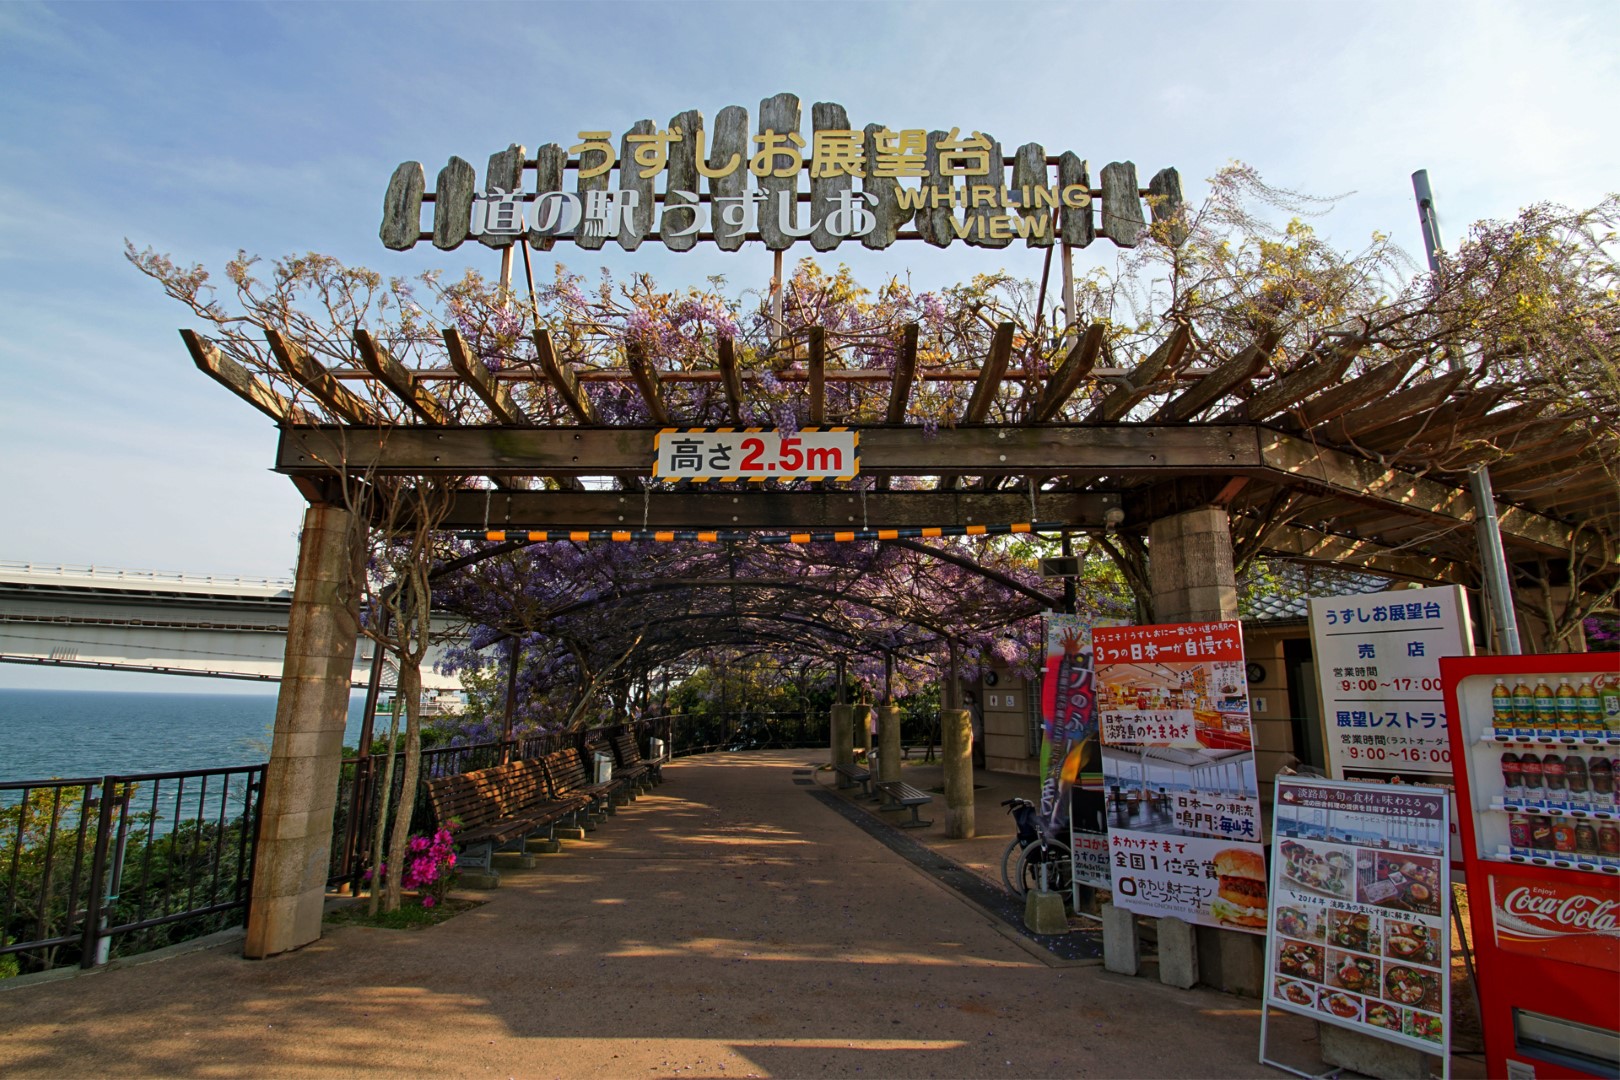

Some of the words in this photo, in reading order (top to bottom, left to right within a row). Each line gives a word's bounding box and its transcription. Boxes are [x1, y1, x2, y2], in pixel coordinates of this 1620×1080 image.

[568, 126, 994, 179] うずしお展望台
[895, 184, 1091, 209] WHIRLING
[949, 214, 1050, 240] VIEW
[1326, 602, 1441, 625] うずしお展望台
[1333, 666, 1378, 677] 営業時間
[1106, 714, 1174, 724] 日本一おいしい
[1106, 724, 1190, 740] 淡路島のたまねぎ
[1178, 797, 1255, 818] 日本一の潮流
[1175, 810, 1255, 838] 鳴門海峡
[1112, 836, 1188, 854] おかげさまで
[1113, 851, 1219, 881] 全国1位受賞
[1137, 878, 1213, 898] あわじ島オニオン
[1141, 888, 1211, 909] ビーフバーガー
[1532, 886, 1557, 896] Enjoy!
[1504, 886, 1619, 931] Coca-Cola
